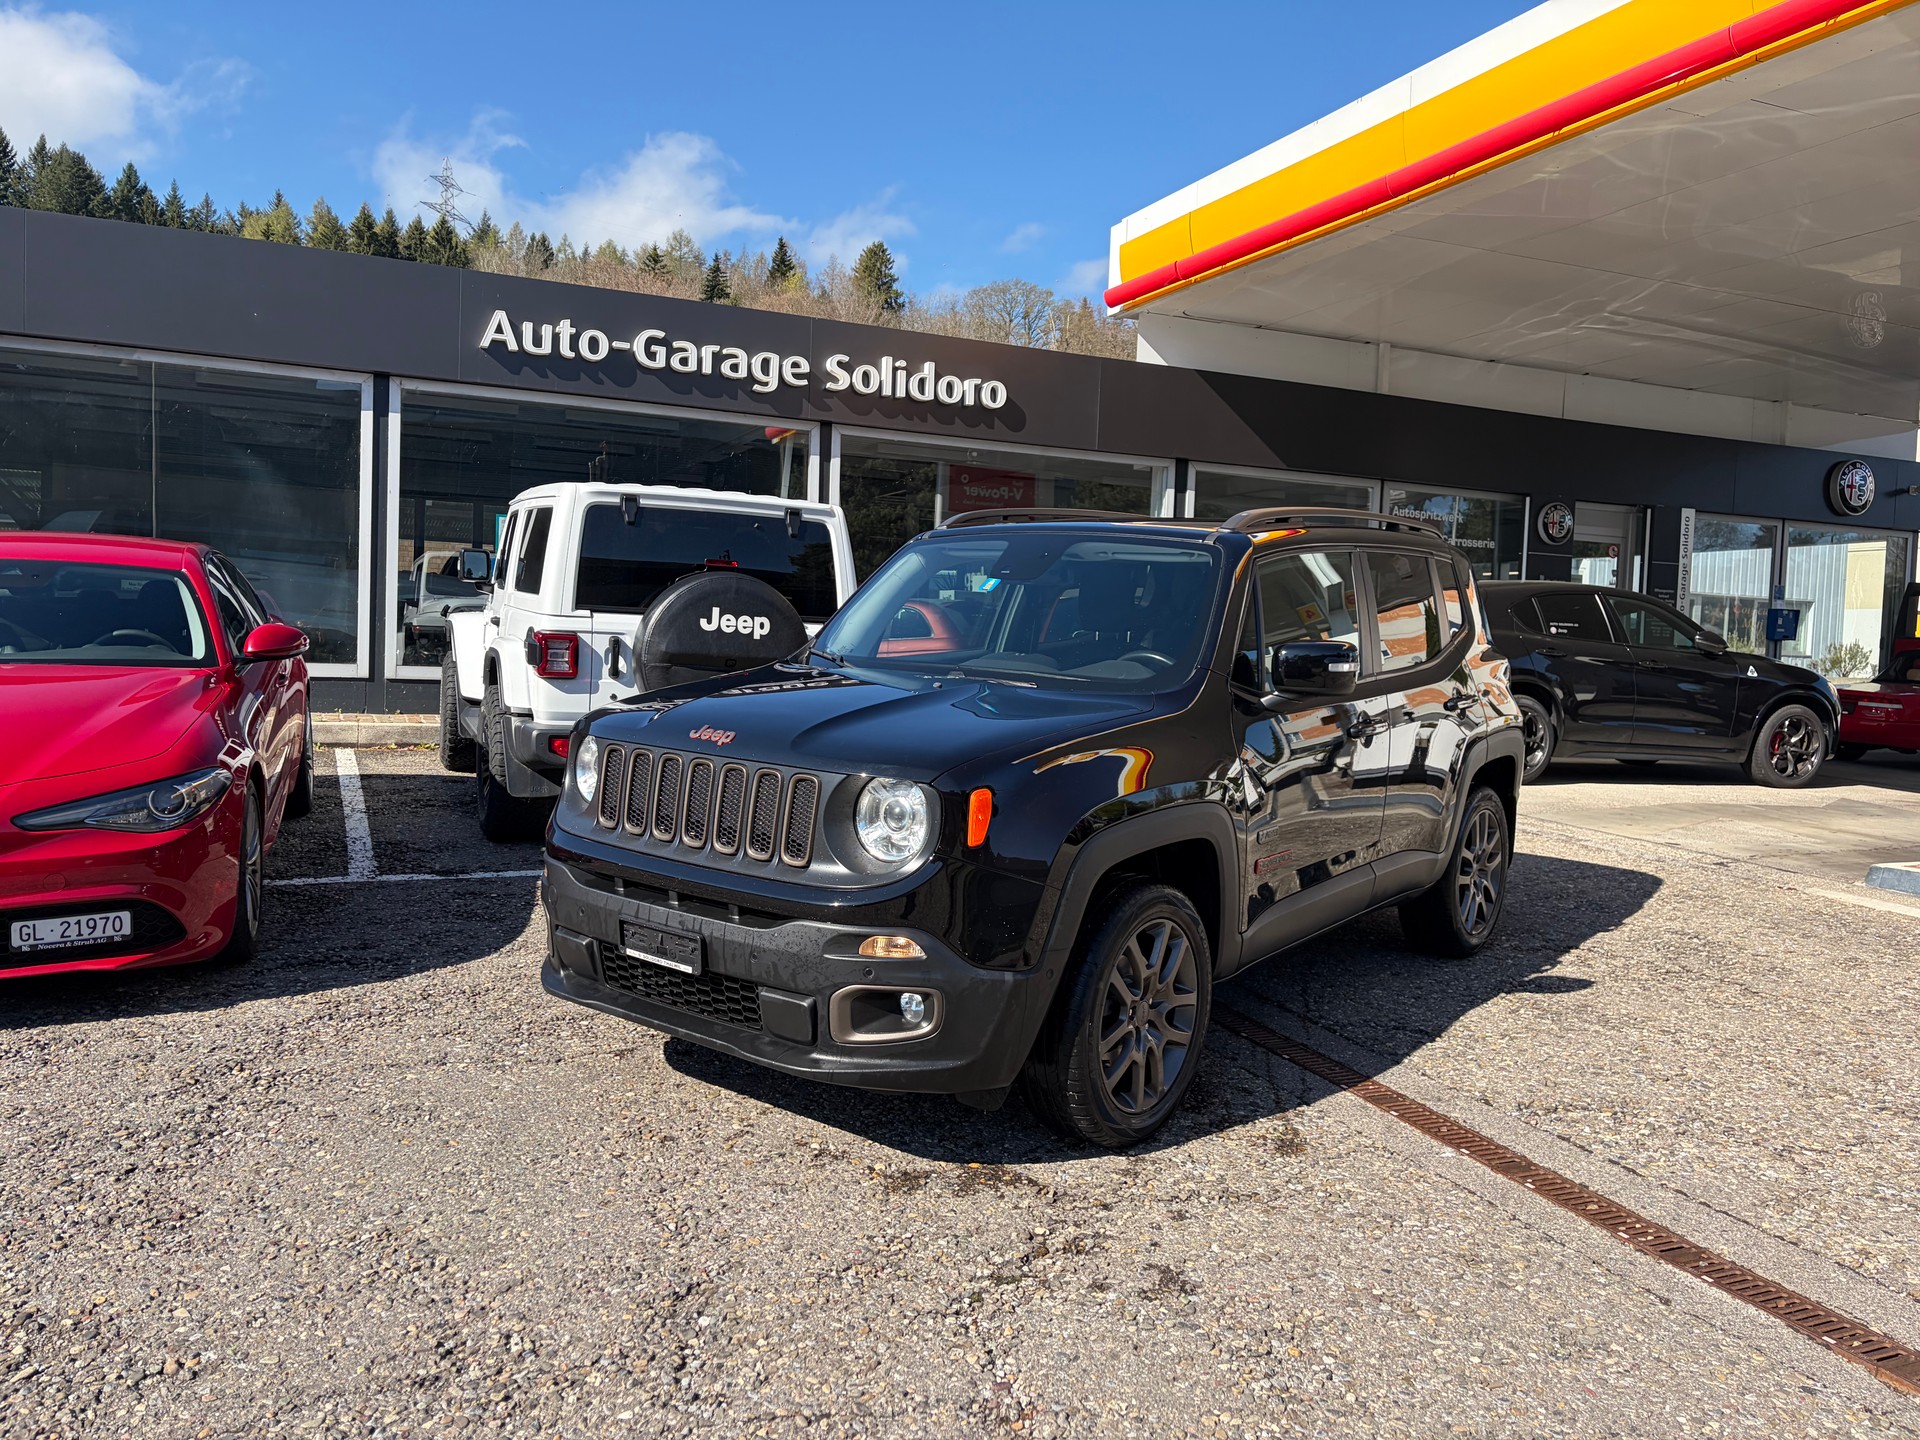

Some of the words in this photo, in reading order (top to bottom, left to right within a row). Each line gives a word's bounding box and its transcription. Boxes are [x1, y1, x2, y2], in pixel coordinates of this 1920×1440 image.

[479, 309, 811, 394] Auto-Garage
[824, 353, 1008, 410] Solidoro
[1393, 505, 1464, 523] Autospritzwerk
[1682, 516, 1690, 559] Solidoro
[1679, 562, 1689, 614] o-Garage
[700, 606, 770, 639] Jeep
[689, 724, 736, 747] Jeep
[19, 924, 44, 942] GL
[60, 915, 123, 939] 21970
[73, 939, 94, 947] Strub
